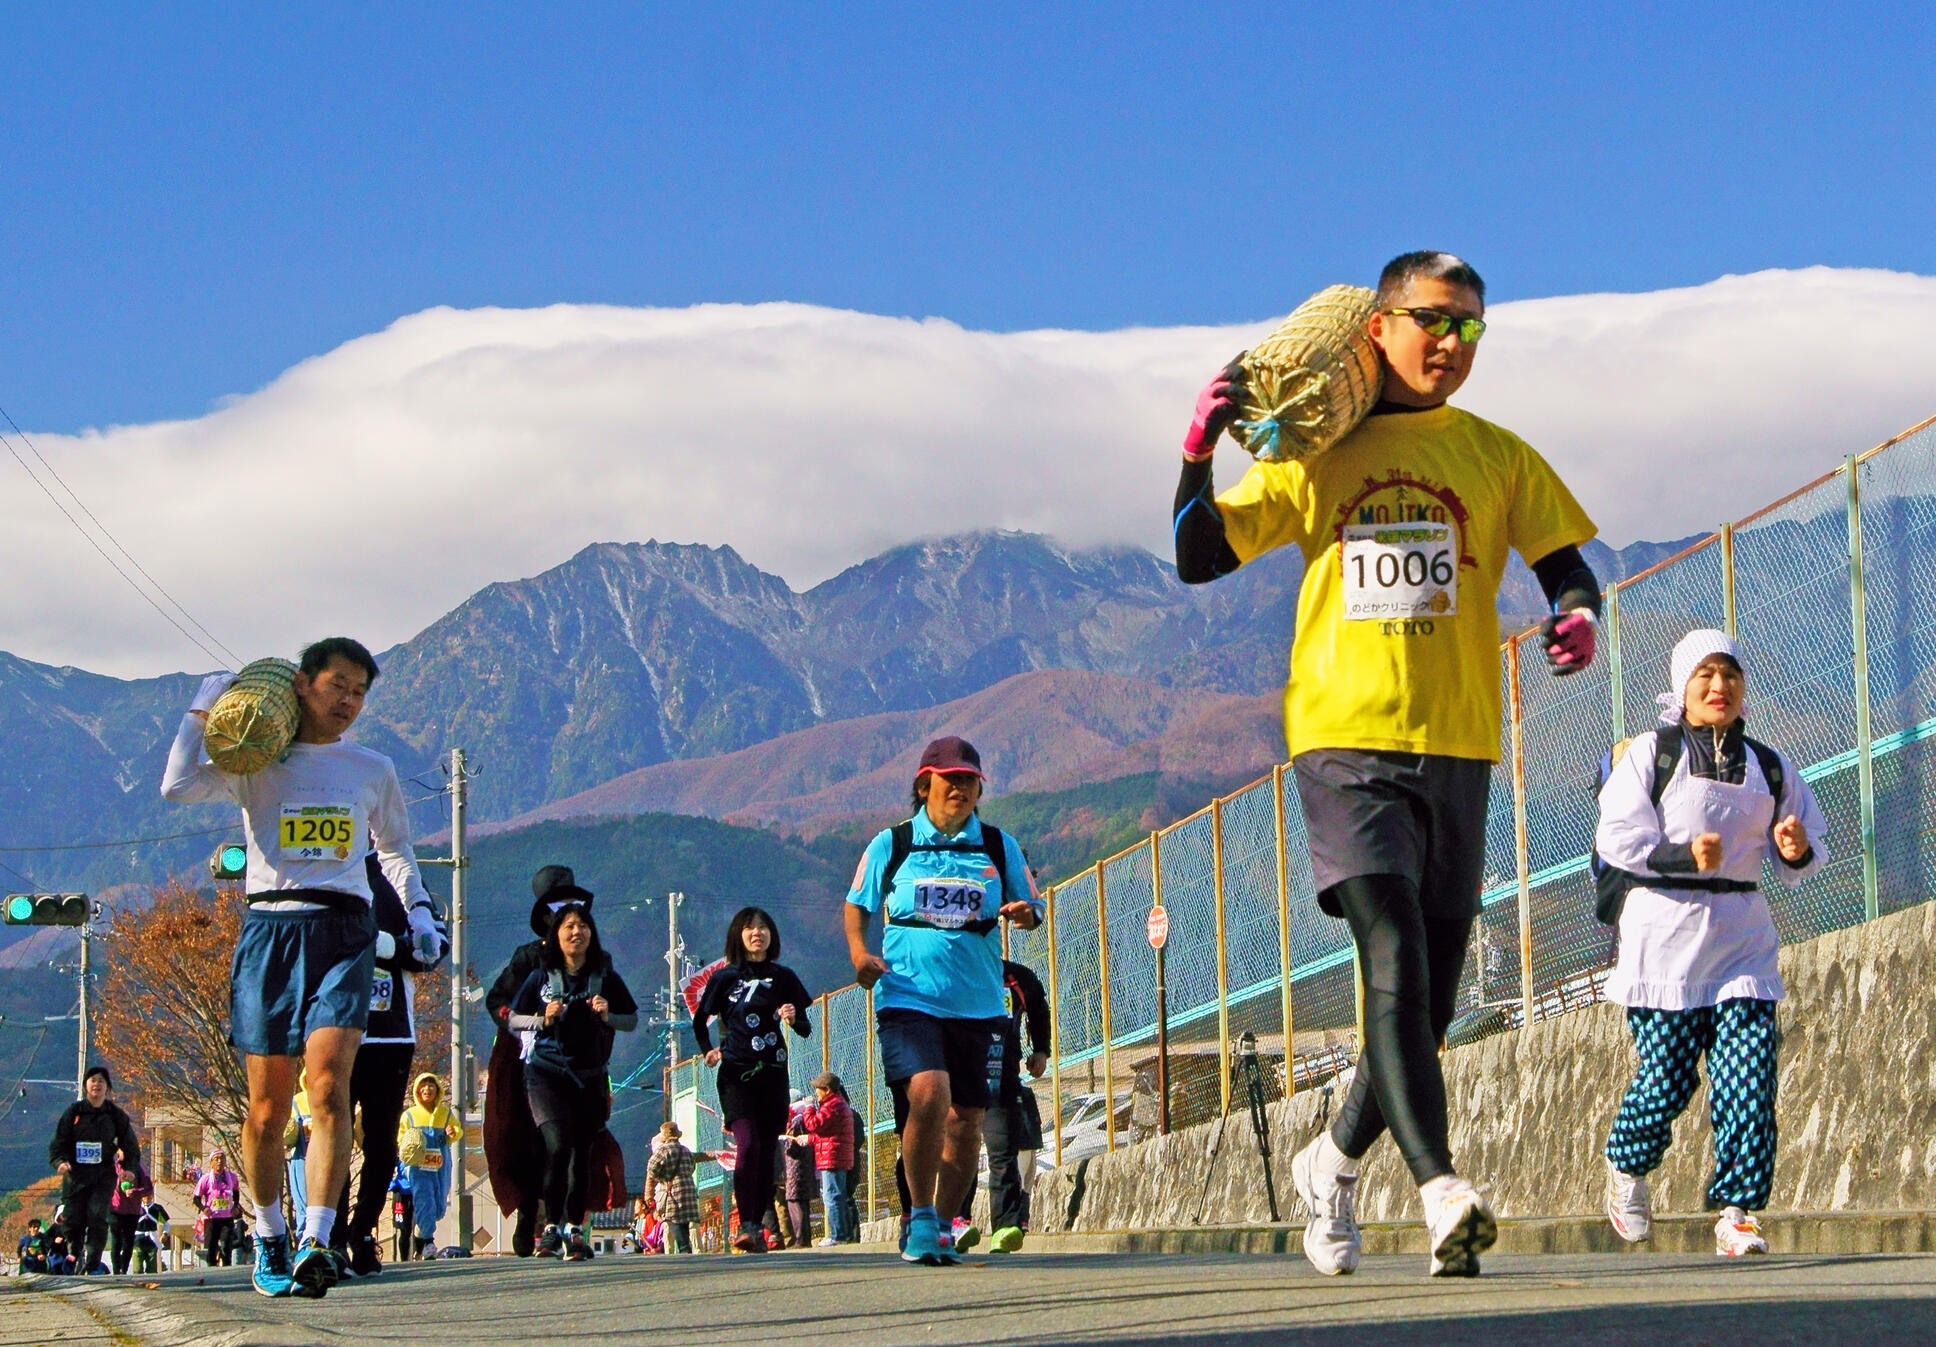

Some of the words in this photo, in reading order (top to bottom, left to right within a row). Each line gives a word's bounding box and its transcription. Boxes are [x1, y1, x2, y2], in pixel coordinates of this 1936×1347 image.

[1351, 549, 1454, 588] 1006
[1352, 601, 1431, 613] のどかクリニック
[285, 819, 351, 843] 1205
[919, 886, 982, 912] 1348
[77, 1148, 100, 1158] 1395
